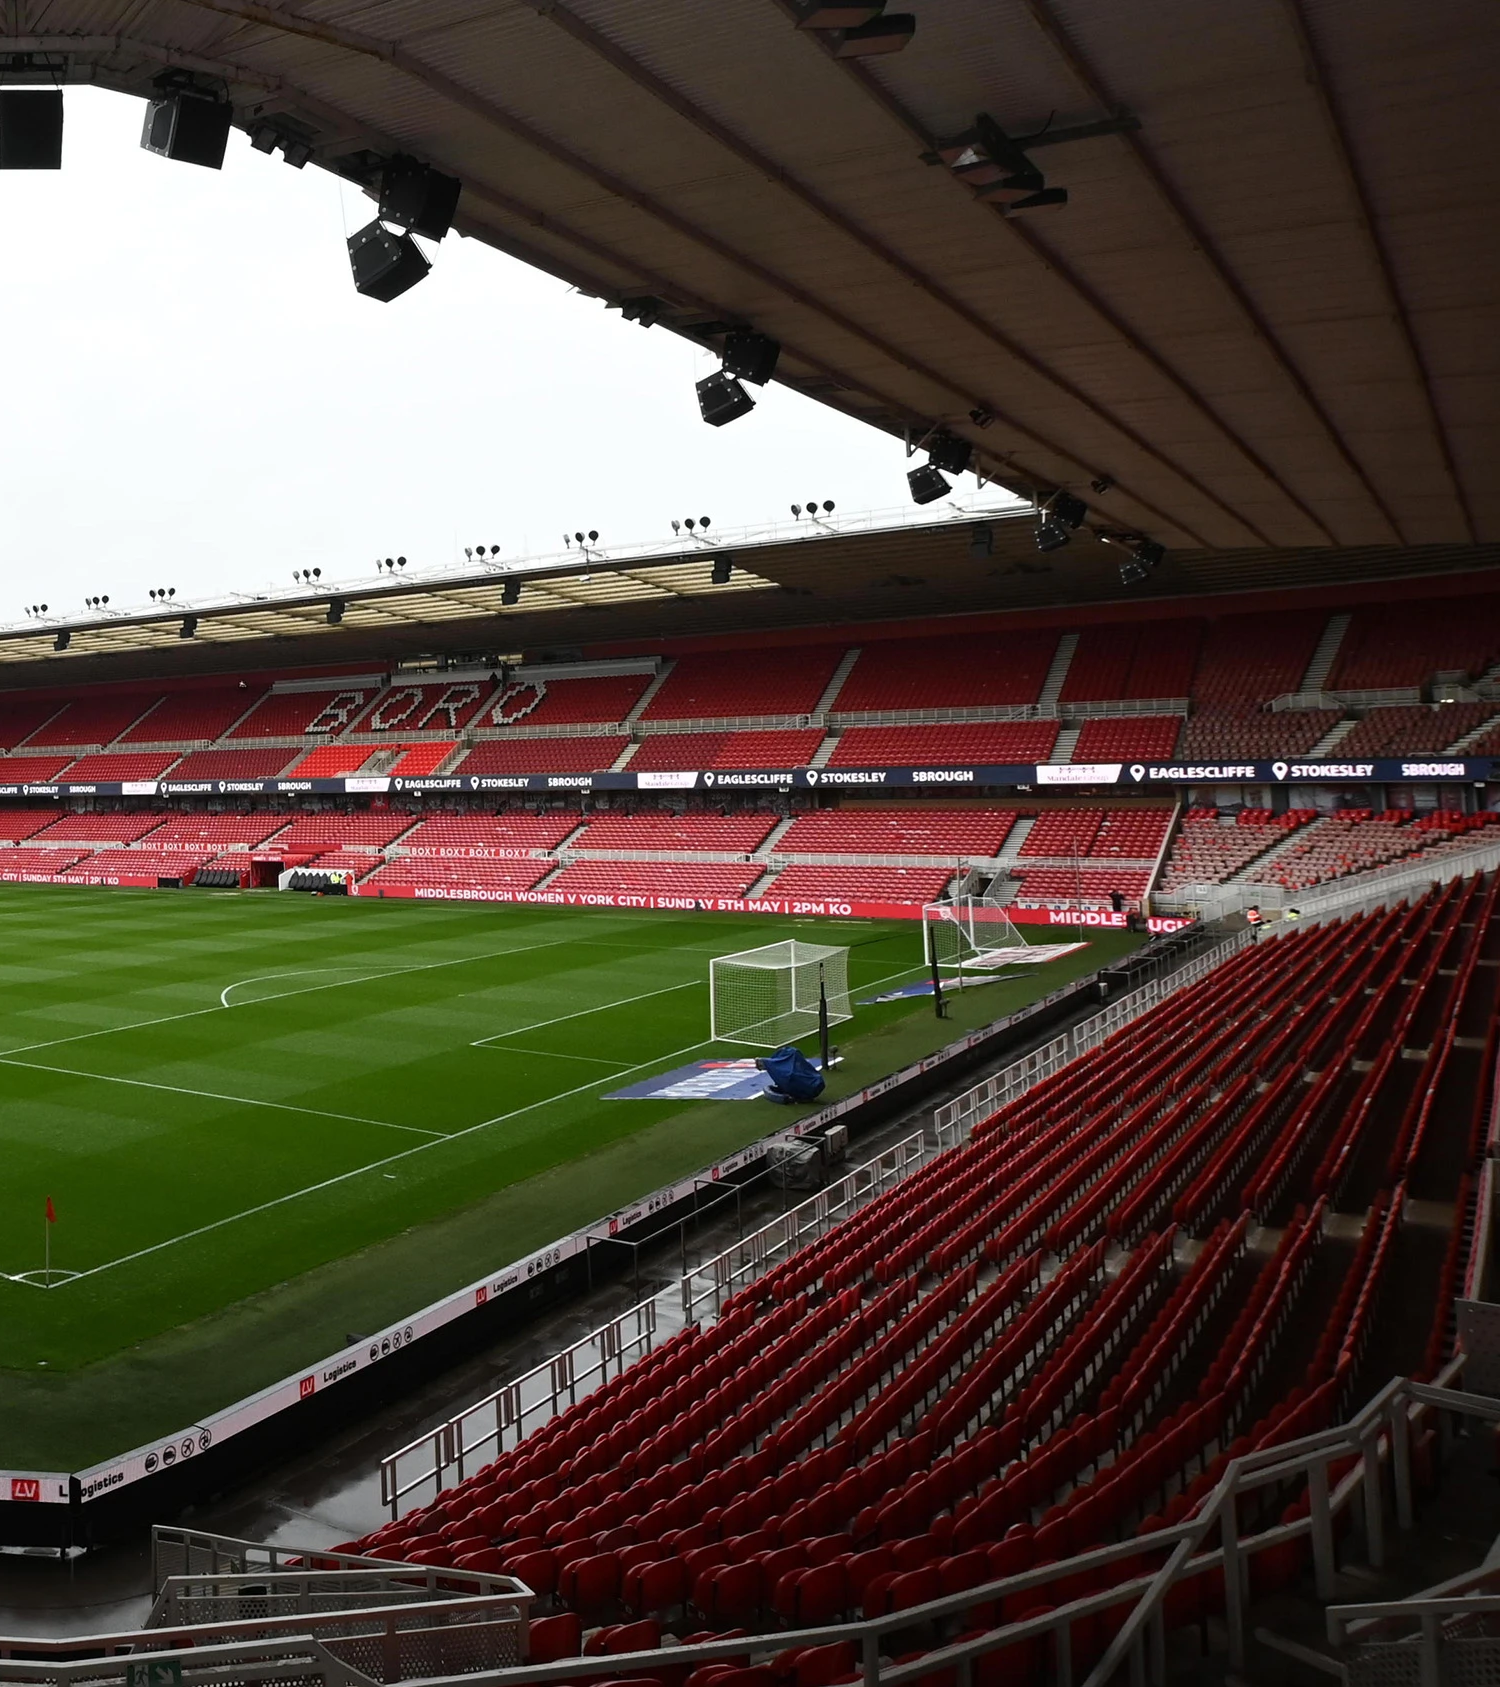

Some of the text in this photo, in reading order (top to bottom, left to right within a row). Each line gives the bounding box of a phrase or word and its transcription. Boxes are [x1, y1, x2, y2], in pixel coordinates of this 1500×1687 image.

[305, 681, 547, 733] BORO
[717, 771, 974, 785] EAGLESCLIFFE STOKESLEY SBROUGH
[1149, 763, 1465, 779] EAGLESCLIFFE STOKESLEY SBROUGH
[29, 786, 59, 794] STOKESLEY
[168, 783, 212, 791] EAGLESCLIFFE
[227, 782, 264, 791] STOKESLEY
[405, 779, 461, 788] EAGLESCLIFFE
[481, 778, 529, 788] STOKESLEY
[2, 873, 18, 881] CITY
[22, 873, 51, 883] SUNDAY
[53, 875, 66, 883] 5TH
[68, 876, 84, 884] MAY
[108, 877, 119, 885] KO
[415, 888, 513, 902] MIDDLESBROUGH
[515, 891, 564, 904] WOMEN
[566, 893, 577, 904] V
[579, 894, 614, 906] YORK
[617, 895, 646, 908] CITY
[717, 899, 744, 911] 5TH
[749, 900, 780, 913] MAY
[793, 902, 825, 914] 2PM
[829, 903, 852, 915] KO
[622, 1210, 642, 1225] Logistics
[493, 1274, 518, 1293] Logistics
[323, 1359, 357, 1383] Logistics
